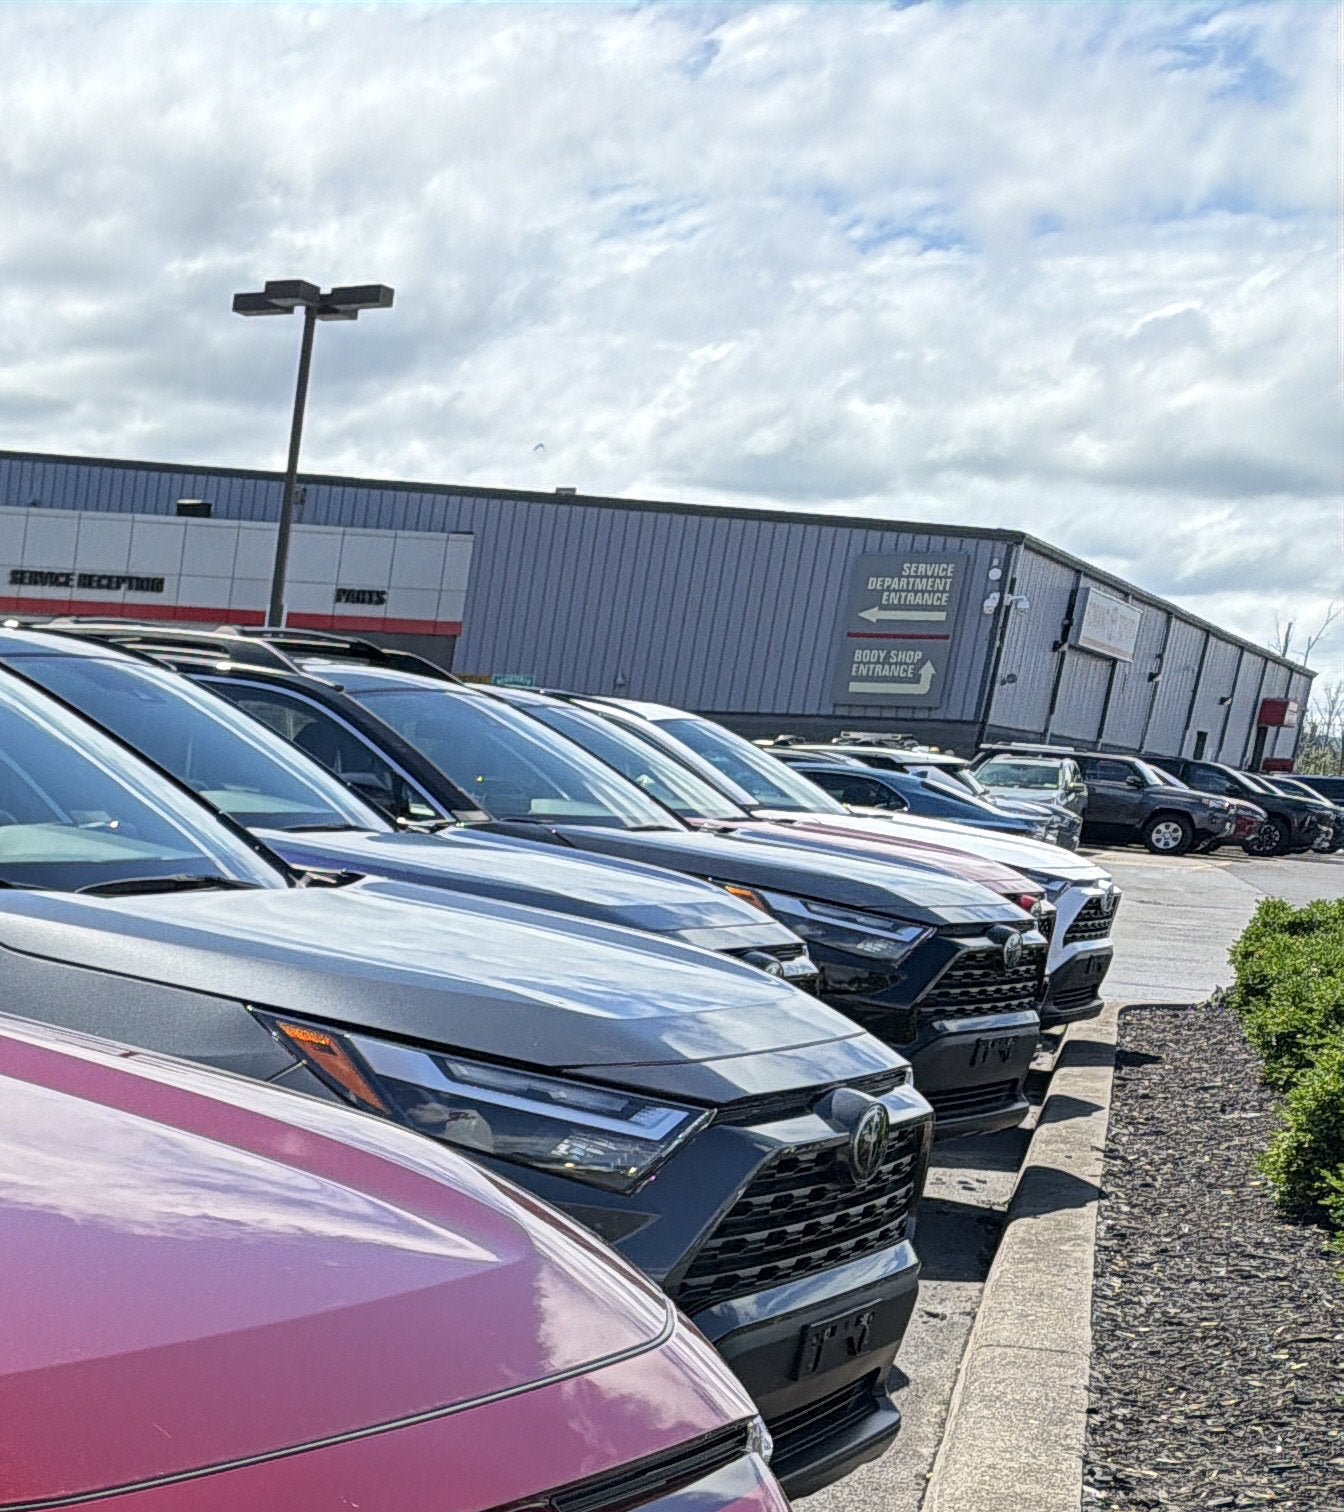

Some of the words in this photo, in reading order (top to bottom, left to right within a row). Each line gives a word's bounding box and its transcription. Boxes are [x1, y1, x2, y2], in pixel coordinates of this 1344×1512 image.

[901, 563, 955, 577] SERVICE
[9, 569, 75, 588] SERVICE
[77, 573, 165, 593] RECEPTION
[867, 577, 953, 591] DEPARTMENT
[335, 588, 387, 606] PARTS
[881, 592, 950, 606] ENTRANCE
[853, 649, 887, 662] BODY
[888, 650, 922, 664] SHOP
[851, 663, 915, 678] ENTRANCE
